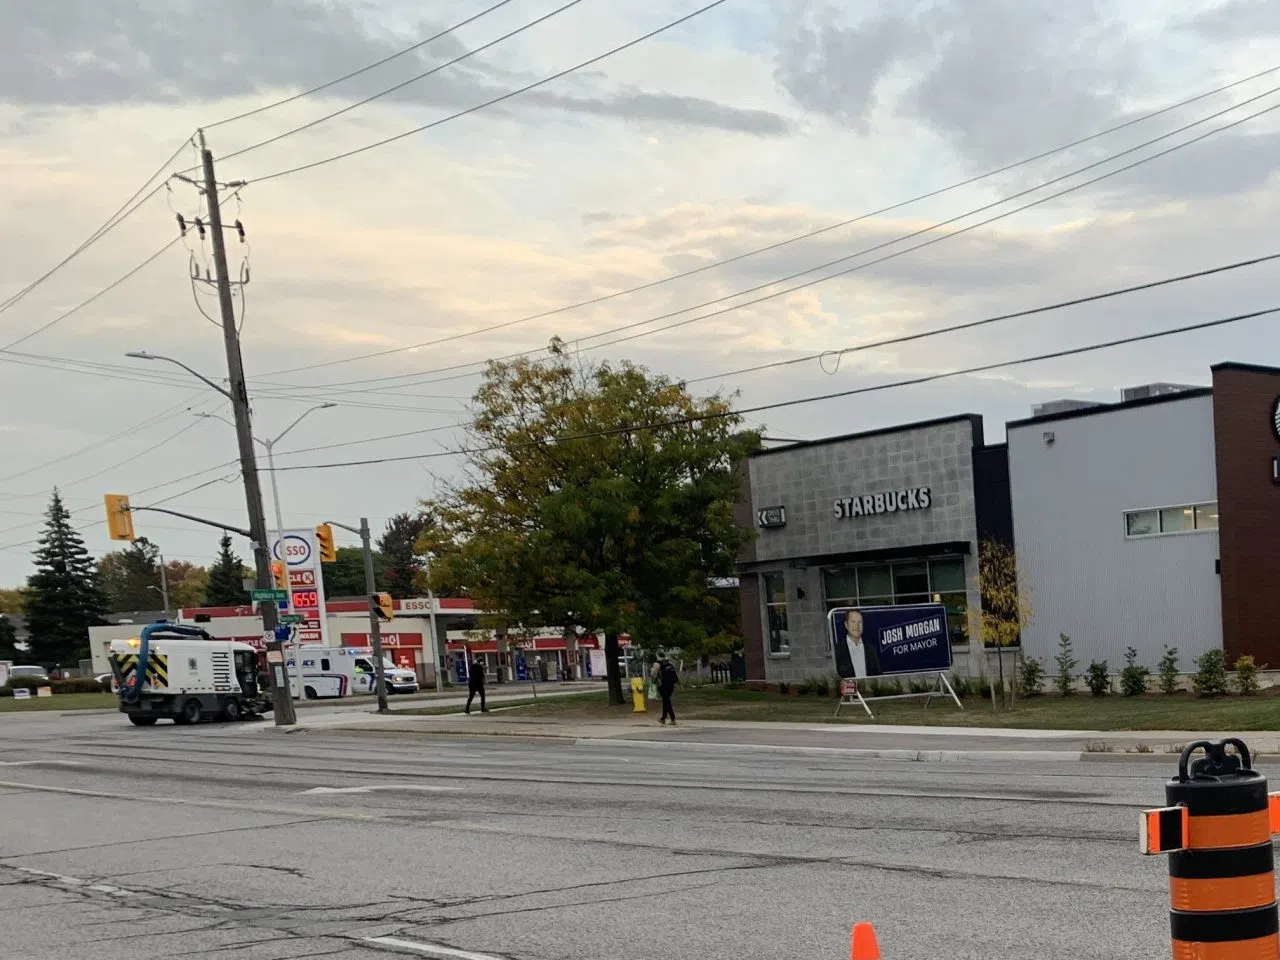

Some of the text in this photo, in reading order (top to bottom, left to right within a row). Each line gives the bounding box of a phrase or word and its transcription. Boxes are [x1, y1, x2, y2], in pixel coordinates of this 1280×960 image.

[834, 487, 930, 519] STARBUCKS
[286, 545, 306, 556] SSO
[881, 618, 940, 645] JOSH MORGAN
[893, 638, 938, 656] FOR MAYOR
[287, 659, 316, 667] POICE
